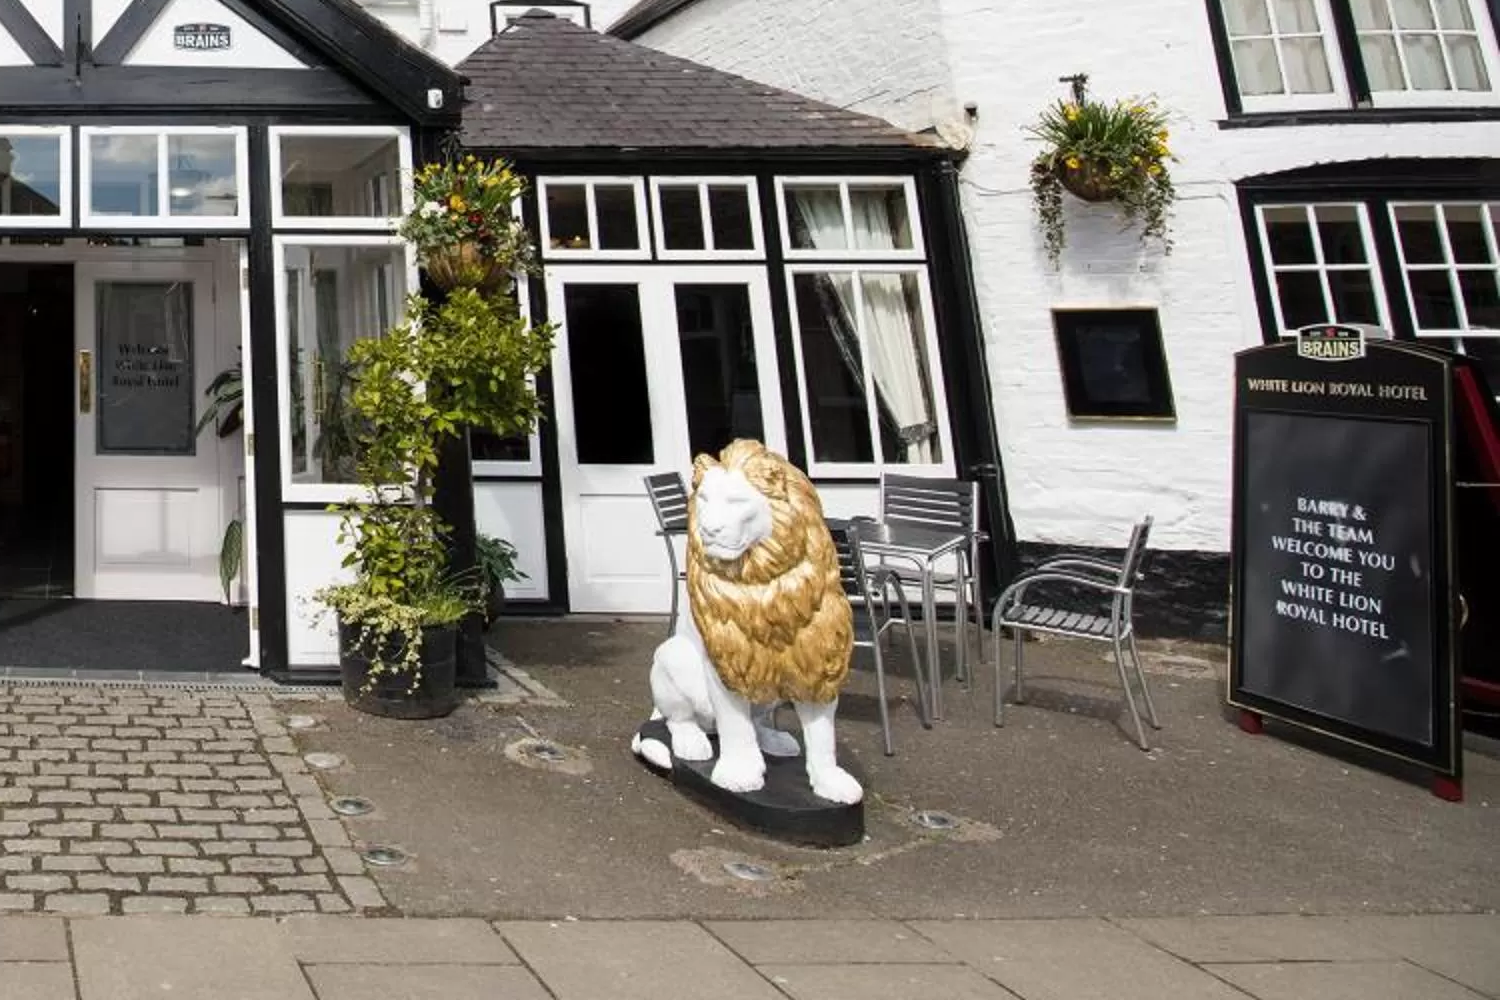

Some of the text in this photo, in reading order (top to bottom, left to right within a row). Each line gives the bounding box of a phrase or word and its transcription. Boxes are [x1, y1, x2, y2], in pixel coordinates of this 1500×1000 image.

[175, 34, 229, 50] BRAINS
[1302, 341, 1360, 357] BRAINS
[1247, 377, 1428, 401] WHITE LION ROYAL HOTEL
[1297, 497, 1367, 521] BARRY &
[1292, 517, 1375, 545] THE TEAM
[1271, 535, 1396, 571] WELCOME YOU
[1300, 561, 1363, 588] TO THE
[1281, 578, 1382, 615] WHITE LION
[1275, 599, 1389, 640] ROYAL HOTEL
